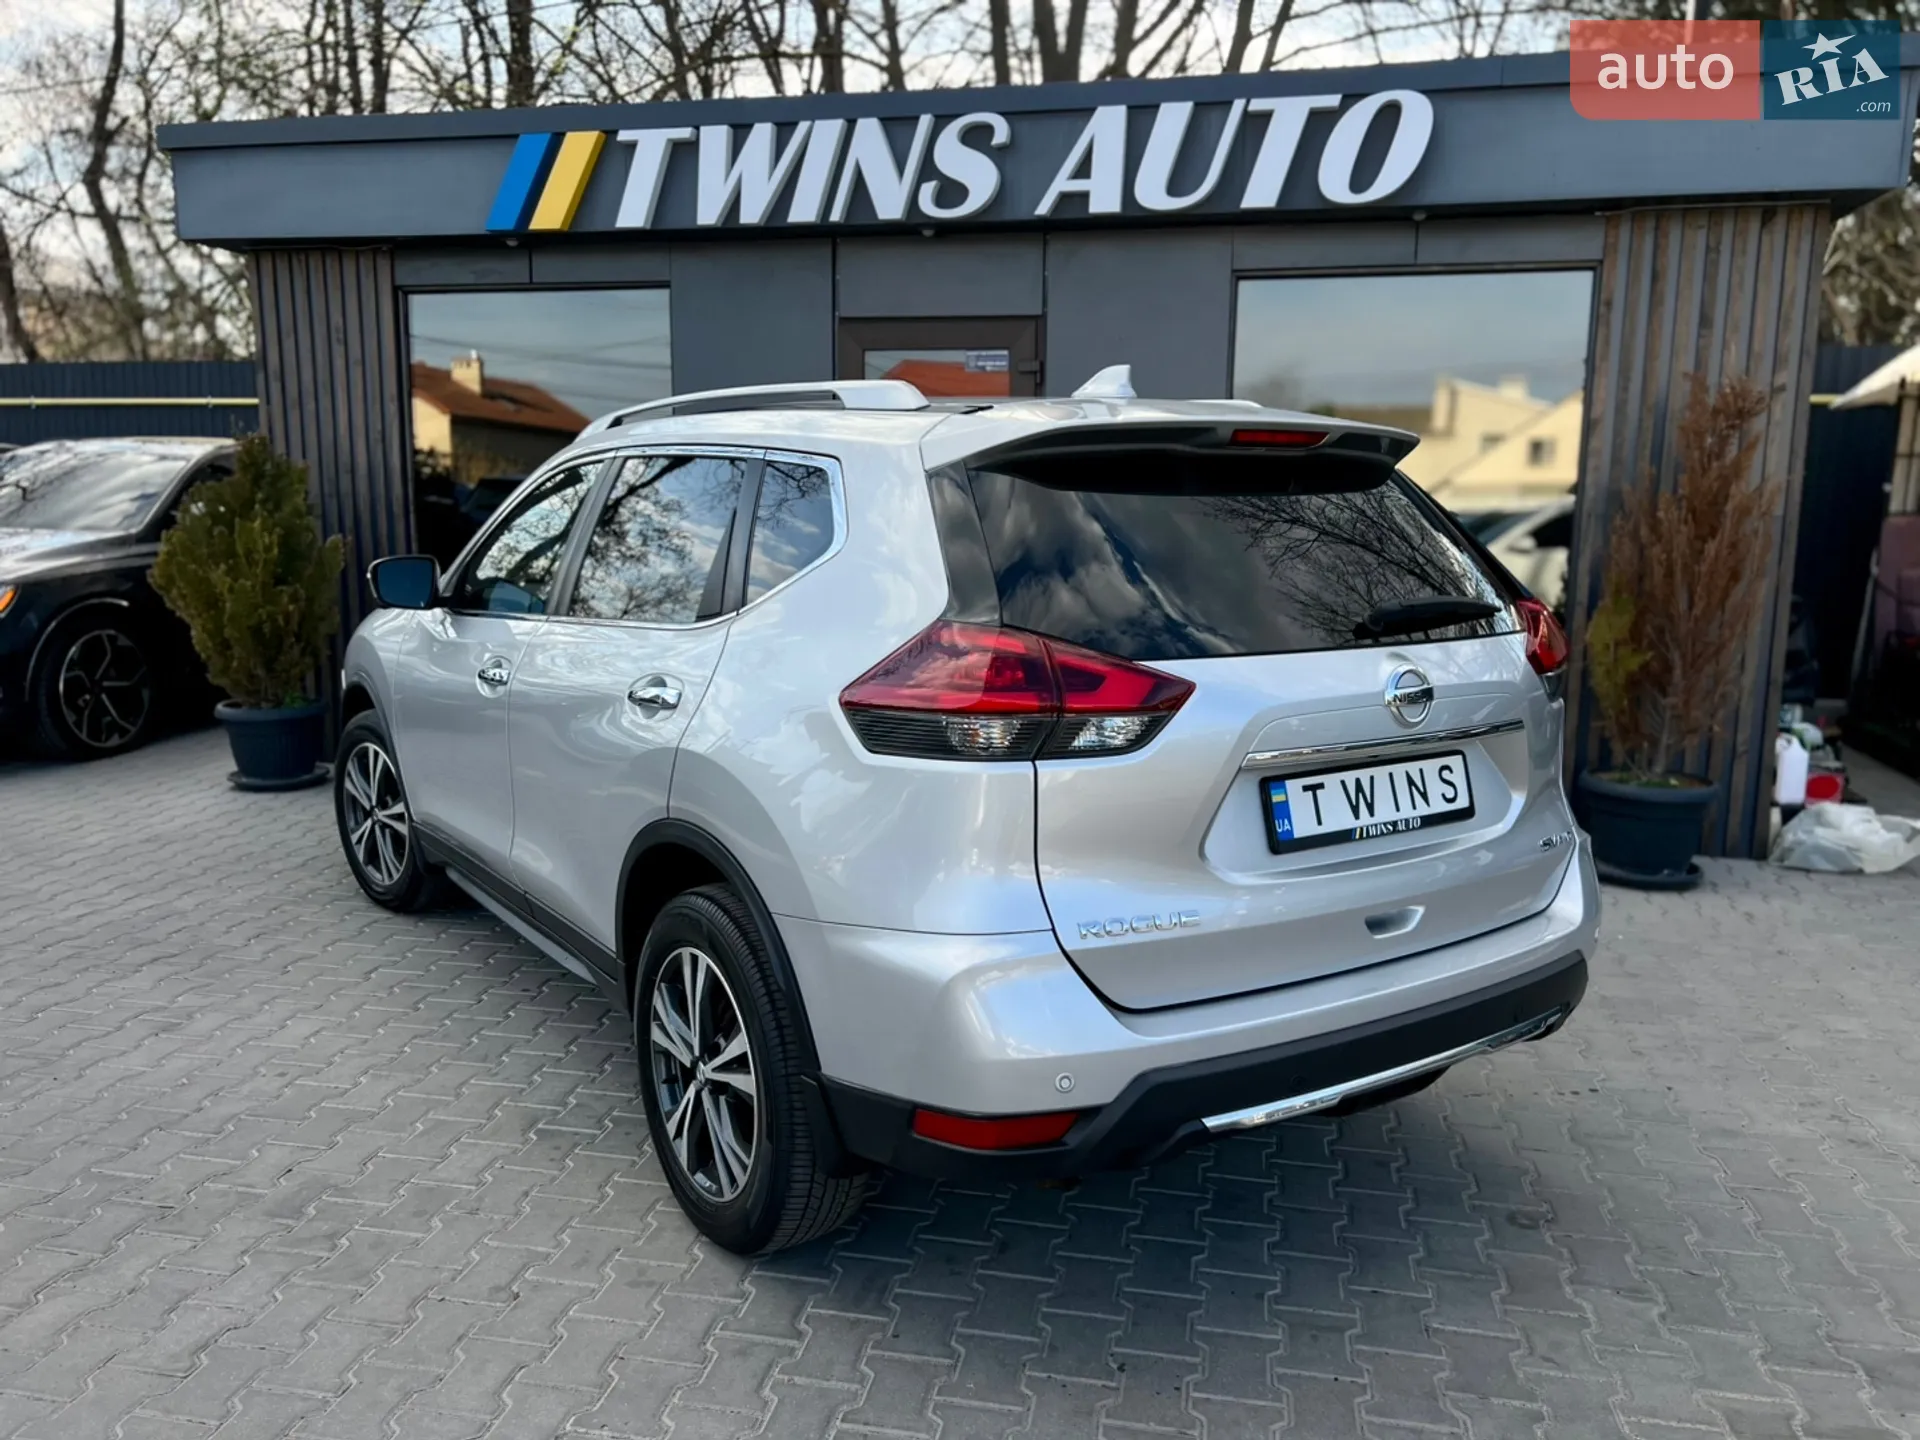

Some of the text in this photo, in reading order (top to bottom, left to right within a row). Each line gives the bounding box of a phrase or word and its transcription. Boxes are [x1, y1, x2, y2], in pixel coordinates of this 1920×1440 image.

[614, 89, 1436, 230] TWINS AUTO
[1301, 764, 1459, 827] TWINS
[1275, 818, 1292, 833] UA
[1362, 816, 1421, 838] TWINS AUTO
[1077, 909, 1200, 940] ROGUE
